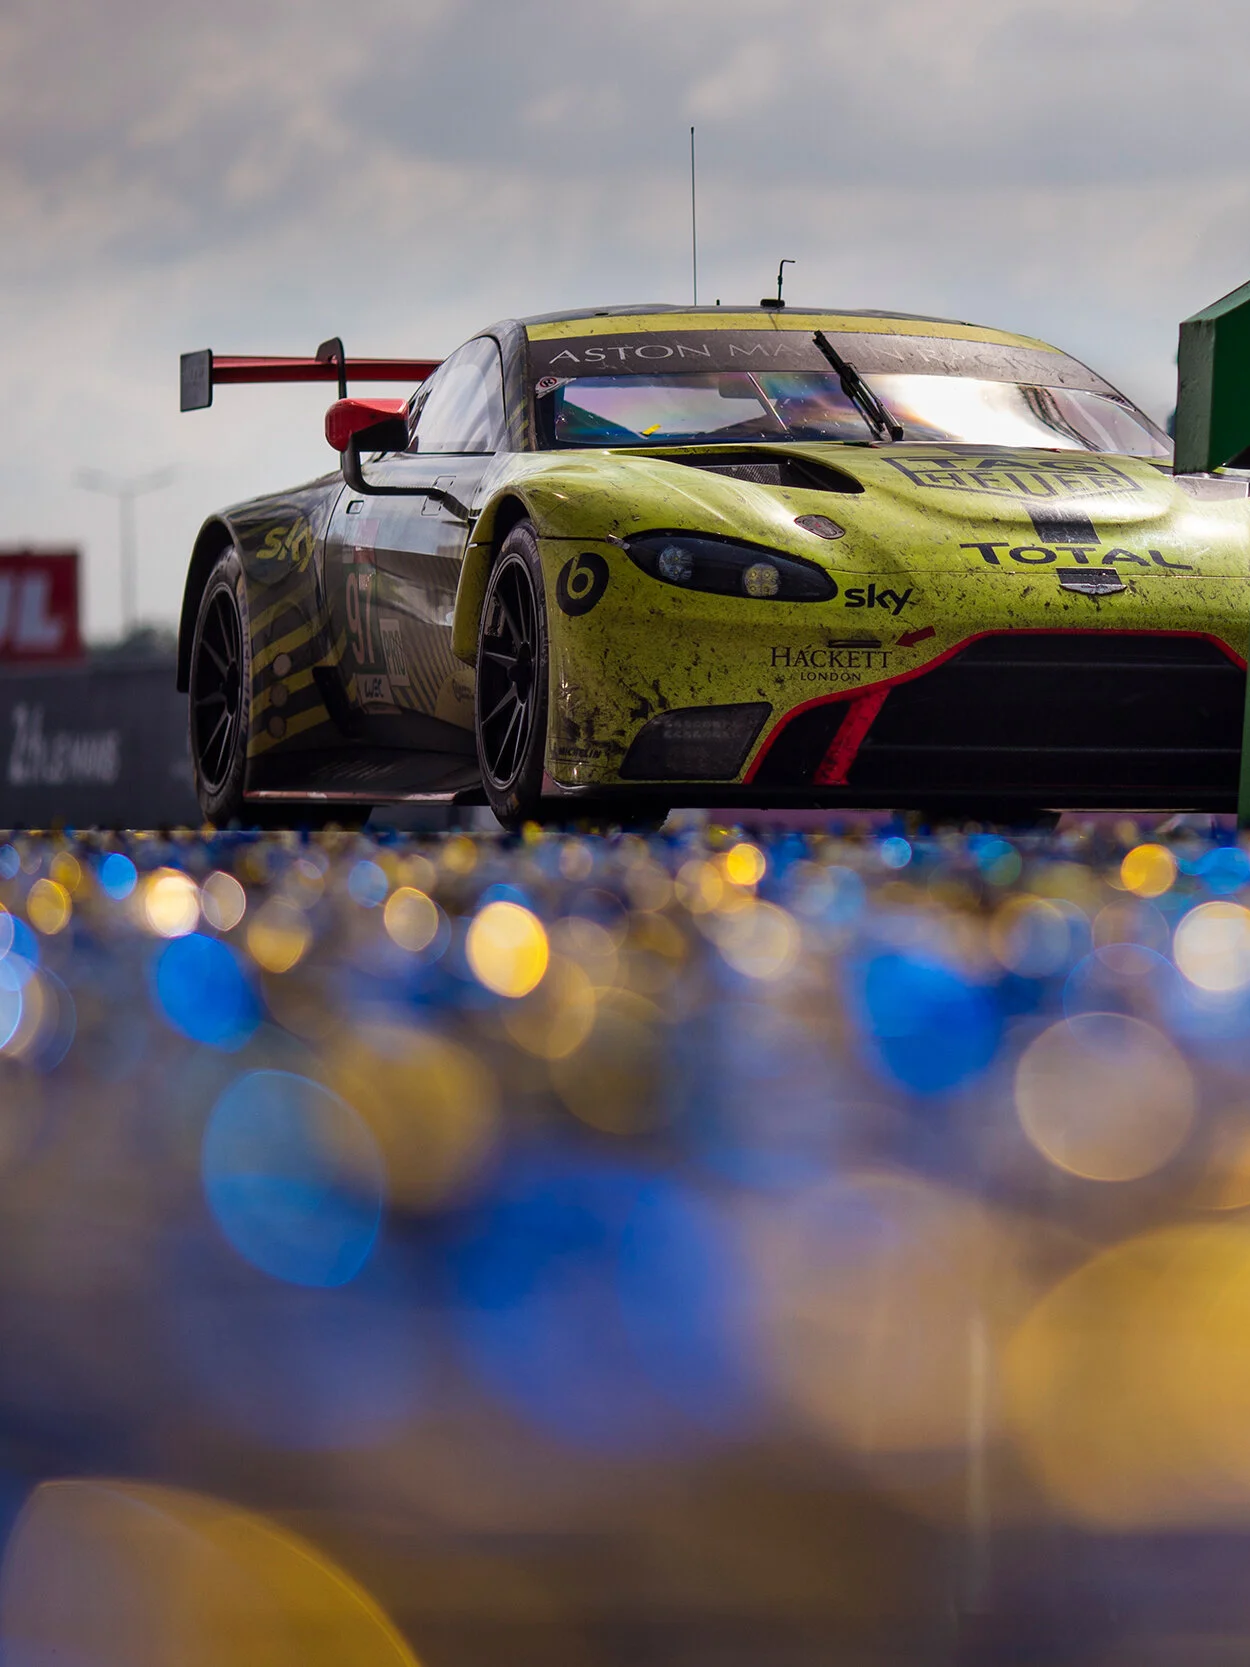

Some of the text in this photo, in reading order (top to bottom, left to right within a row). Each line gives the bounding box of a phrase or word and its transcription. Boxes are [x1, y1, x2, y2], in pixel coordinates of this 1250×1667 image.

[548, 344, 712, 365] ASTON
[728, 342, 905, 362] MAIN
[908, 457, 1101, 473] TAG
[926, 471, 1133, 498] HEUER
[256, 516, 317, 573] sky
[958, 541, 1194, 571] TOTAL
[844, 583, 914, 616] sky
[346, 571, 377, 665] 97
[769, 646, 893, 669] HACKETT
[800, 671, 861, 682] LONDON
